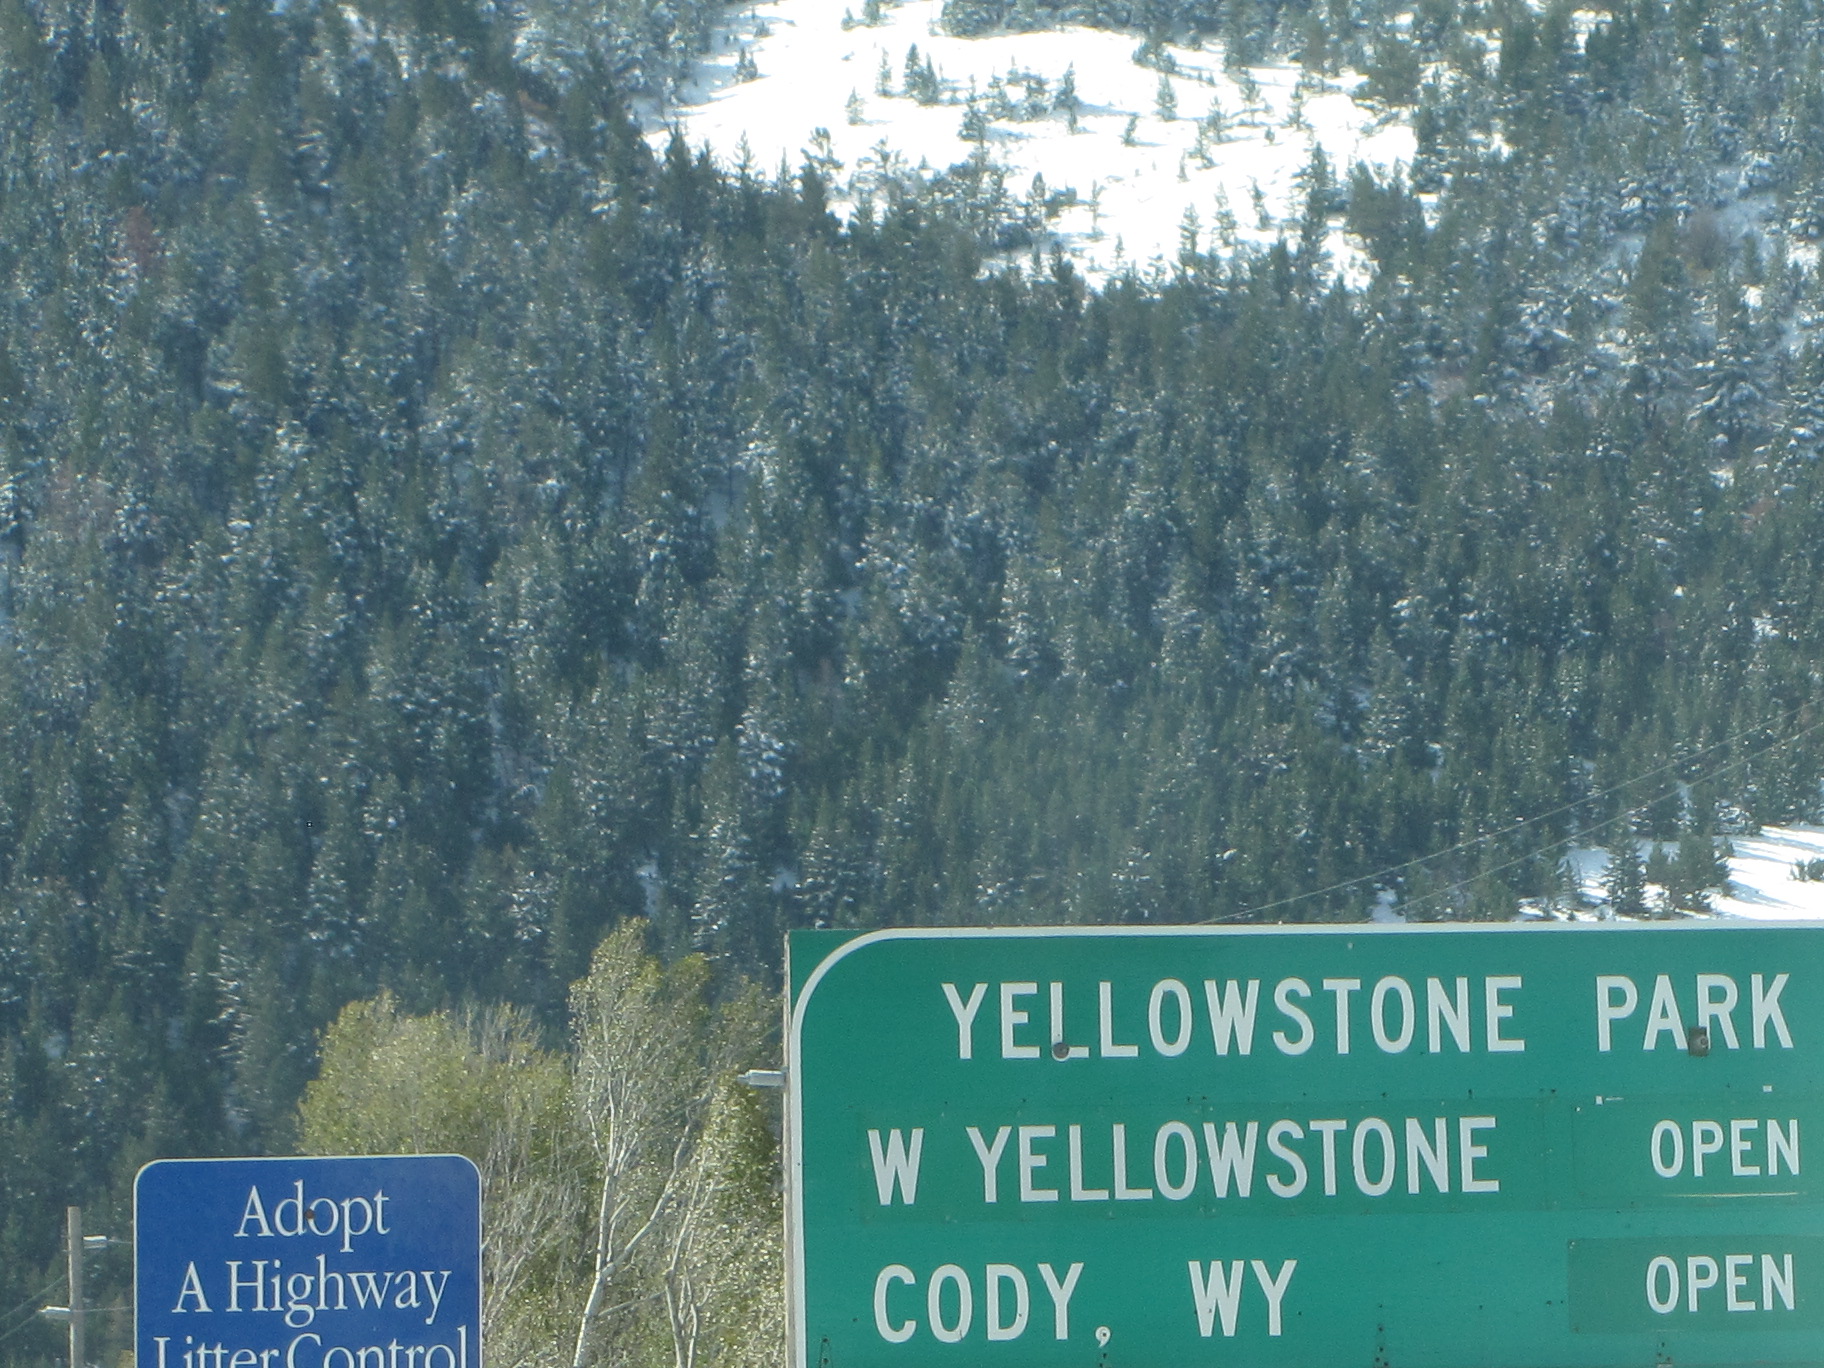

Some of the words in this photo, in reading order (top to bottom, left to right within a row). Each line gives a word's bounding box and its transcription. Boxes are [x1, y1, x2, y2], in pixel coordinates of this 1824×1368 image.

[942, 976, 1524, 1061] YELLOWSTONE
[1597, 974, 1793, 1051] PARK
[868, 1128, 923, 1205] W
[966, 1117, 1499, 1202] YELLOWSTONE
[1651, 1119, 1799, 1177] OPEN
[234, 1180, 389, 1252] Adopt
[172, 1261, 212, 1313] A
[226, 1254, 451, 1327] Highway
[874, 1263, 1110, 1347] CODY,
[1188, 1260, 1297, 1337] WY
[1647, 1254, 1794, 1313] OPEN
